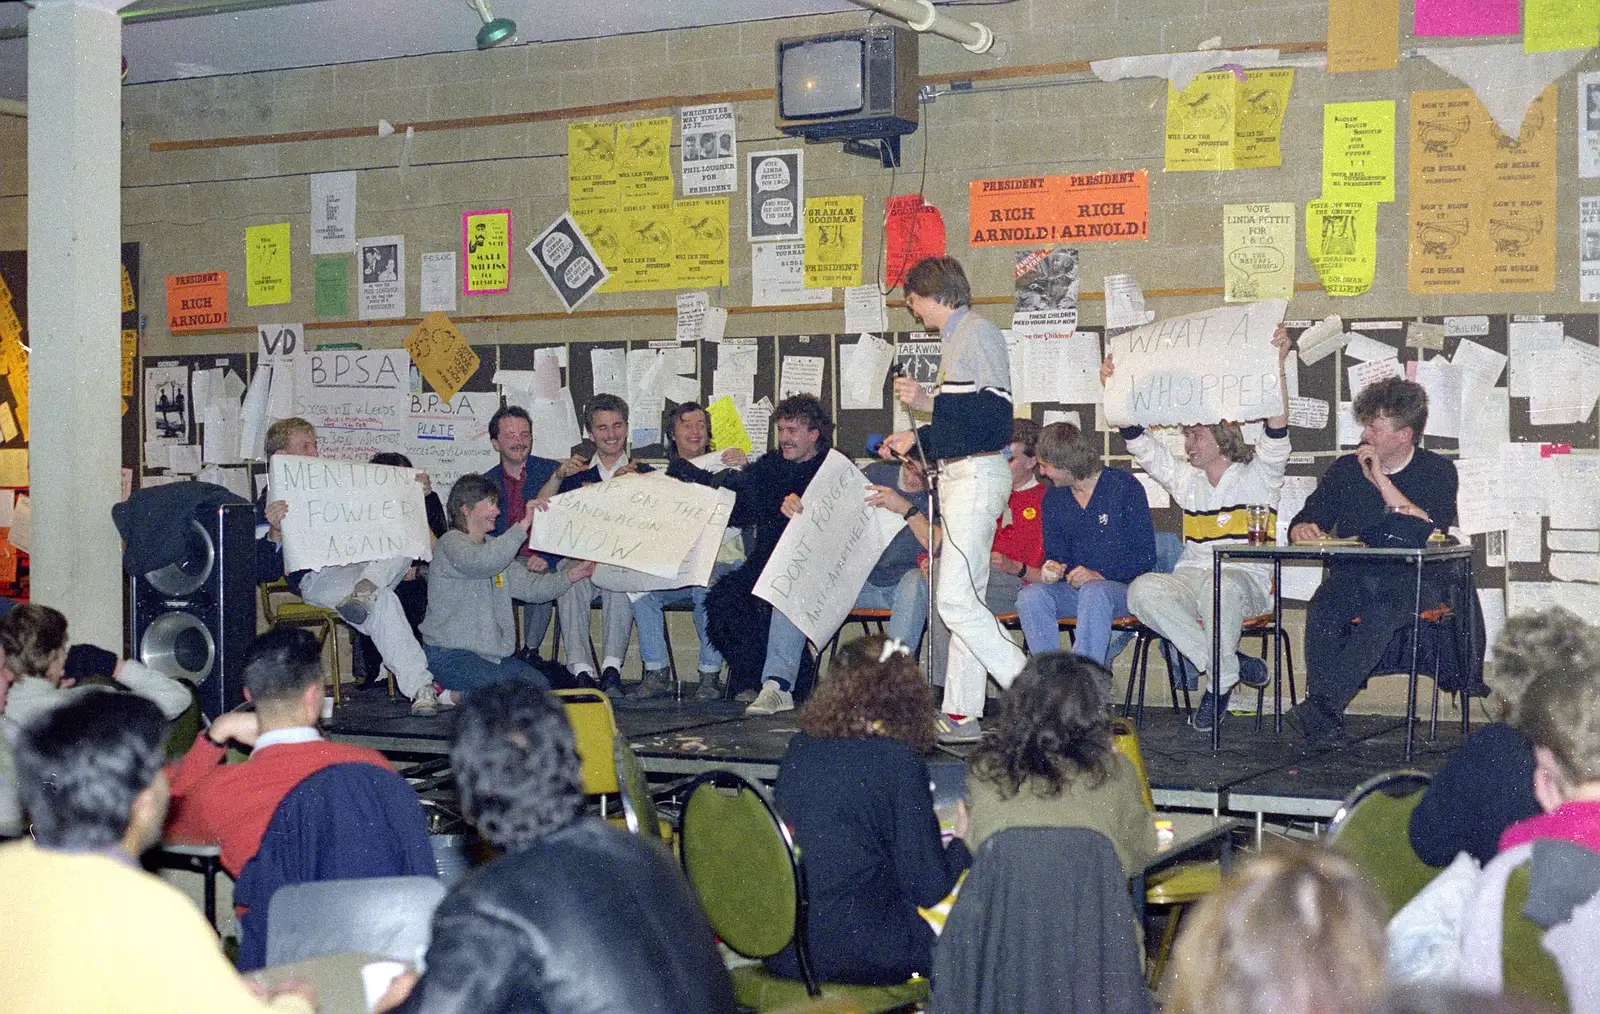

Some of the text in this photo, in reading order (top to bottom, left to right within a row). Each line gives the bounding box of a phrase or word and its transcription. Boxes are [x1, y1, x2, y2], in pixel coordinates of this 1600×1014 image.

[682, 107, 728, 117] WHICHEVER
[982, 178, 1045, 192] PRESIDENT
[1070, 172, 1135, 187] PRESIDENT
[689, 184, 732, 194] PRESIDENT
[808, 208, 854, 216] GRAHAM
[989, 207, 1035, 223] RICH
[1078, 202, 1126, 218] RICH
[1246, 205, 1271, 213] VOTE
[808, 216, 857, 224] GOODMAN
[1227, 215, 1291, 224] LINDA PETTIT
[1249, 226, 1267, 235] FOR
[804, 264, 859, 272] PRESIDENT
[175, 272, 219, 286] PRESIDENT
[180, 297, 213, 310] RICH
[1047, 311, 1076, 319] CHILDREN
[1129, 312, 1250, 353] WHAT A
[261, 328, 297, 355] VD
[311, 354, 400, 384] BPSA
[1130, 372, 1279, 412] WHOPPER
[417, 422, 455, 437] PLATE
[283, 461, 410, 491] MENTION
[630, 491, 705, 520] ON THE
[307, 499, 416, 528] FOWLER
[557, 520, 642, 559] NOW
[327, 535, 404, 560] AGAIN
